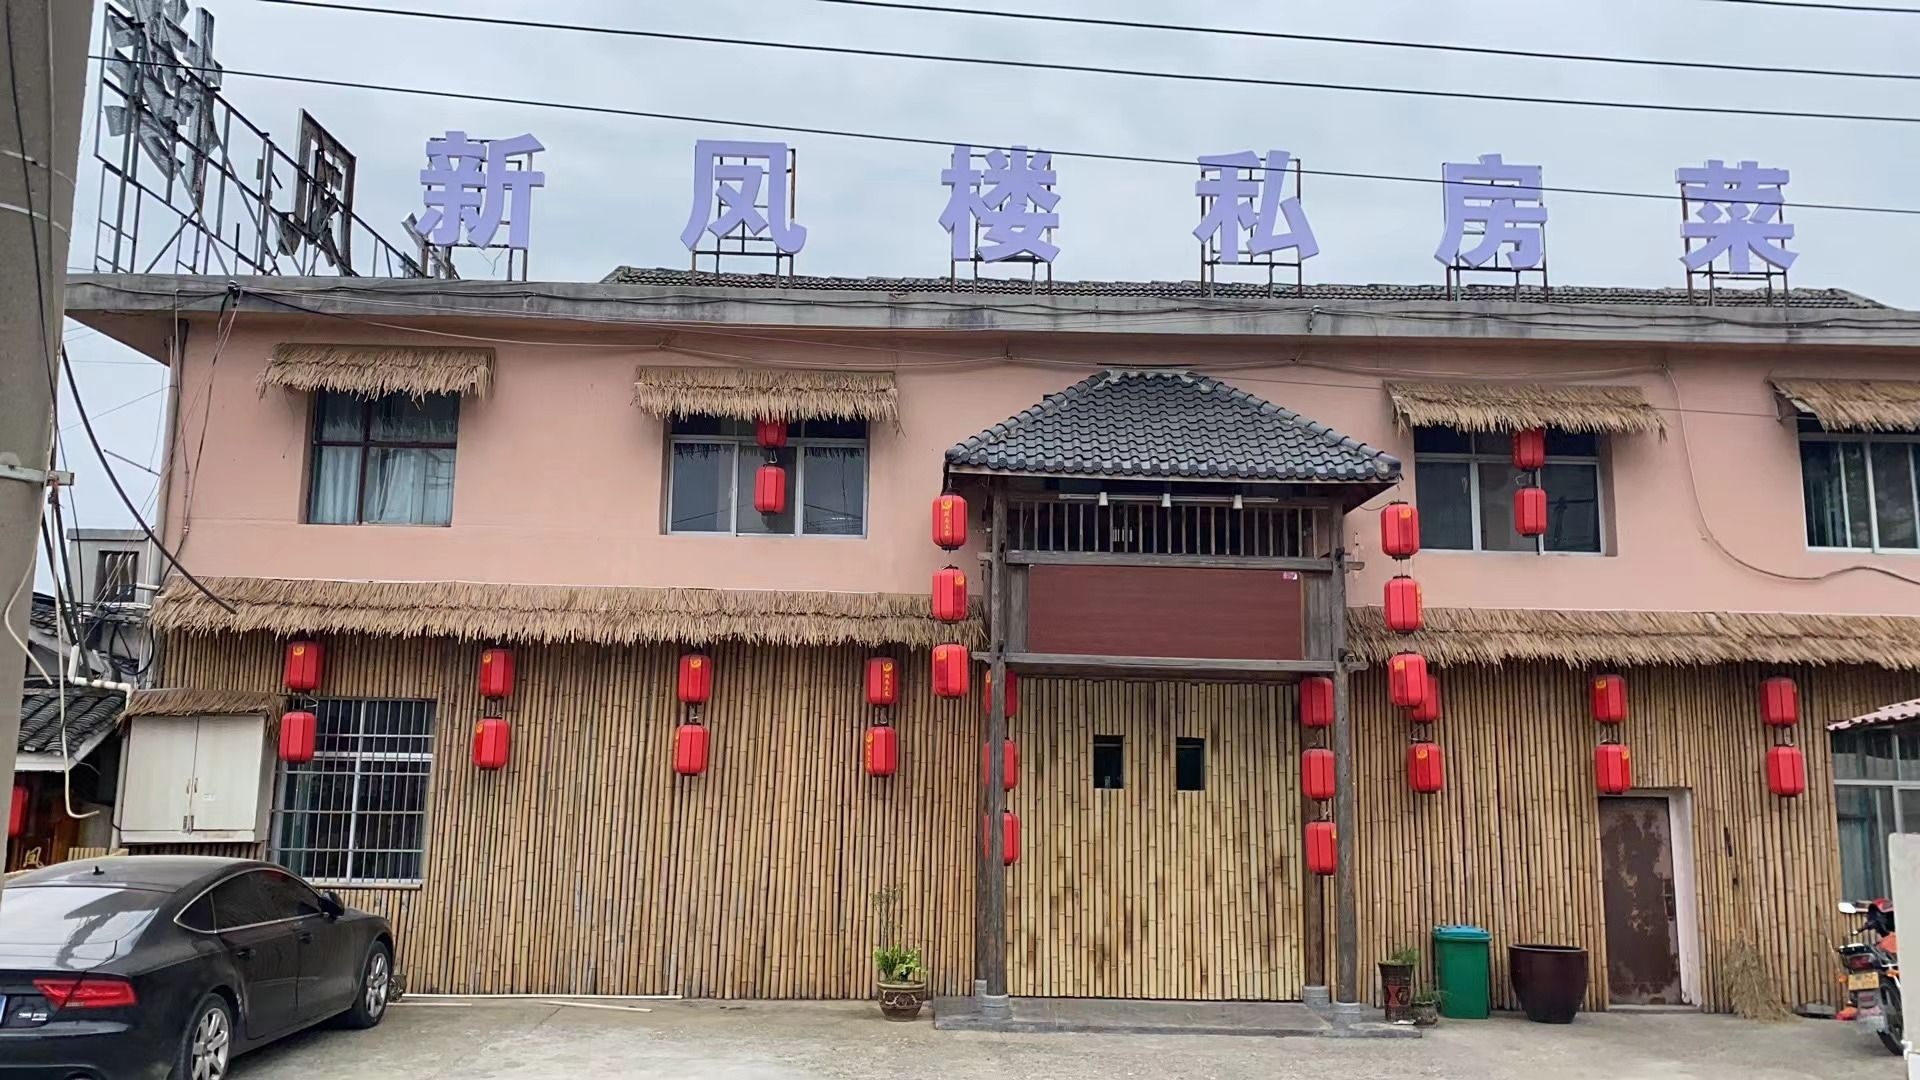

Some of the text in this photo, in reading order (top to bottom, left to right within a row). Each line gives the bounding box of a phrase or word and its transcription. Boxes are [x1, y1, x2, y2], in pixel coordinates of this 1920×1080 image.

[412, 129, 1800, 273] 新凤楼私房菜
